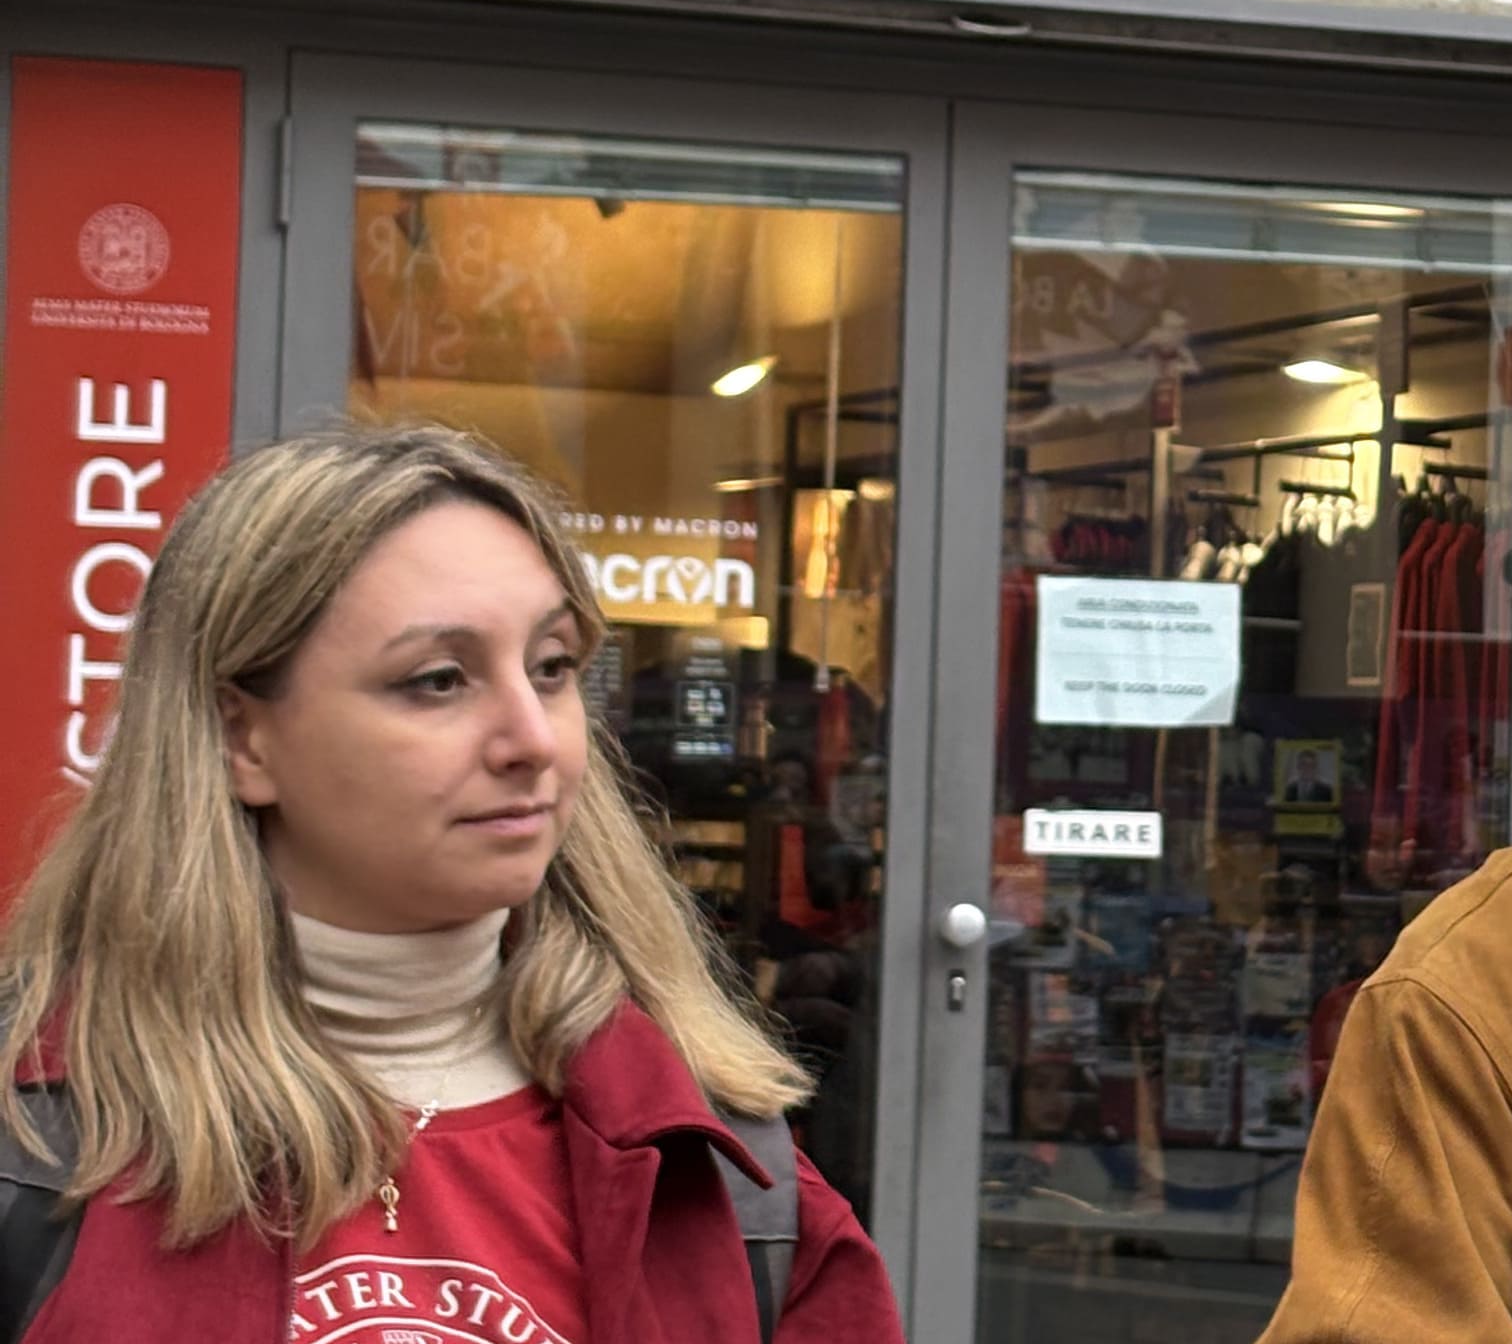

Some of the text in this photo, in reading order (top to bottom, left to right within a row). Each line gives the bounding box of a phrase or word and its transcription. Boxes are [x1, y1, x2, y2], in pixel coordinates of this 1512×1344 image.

[614, 515, 643, 533] BY
[653, 517, 758, 540] MACRON
[1036, 820, 1151, 843] TIRARE
[290, 1270, 416, 1343] ATER
